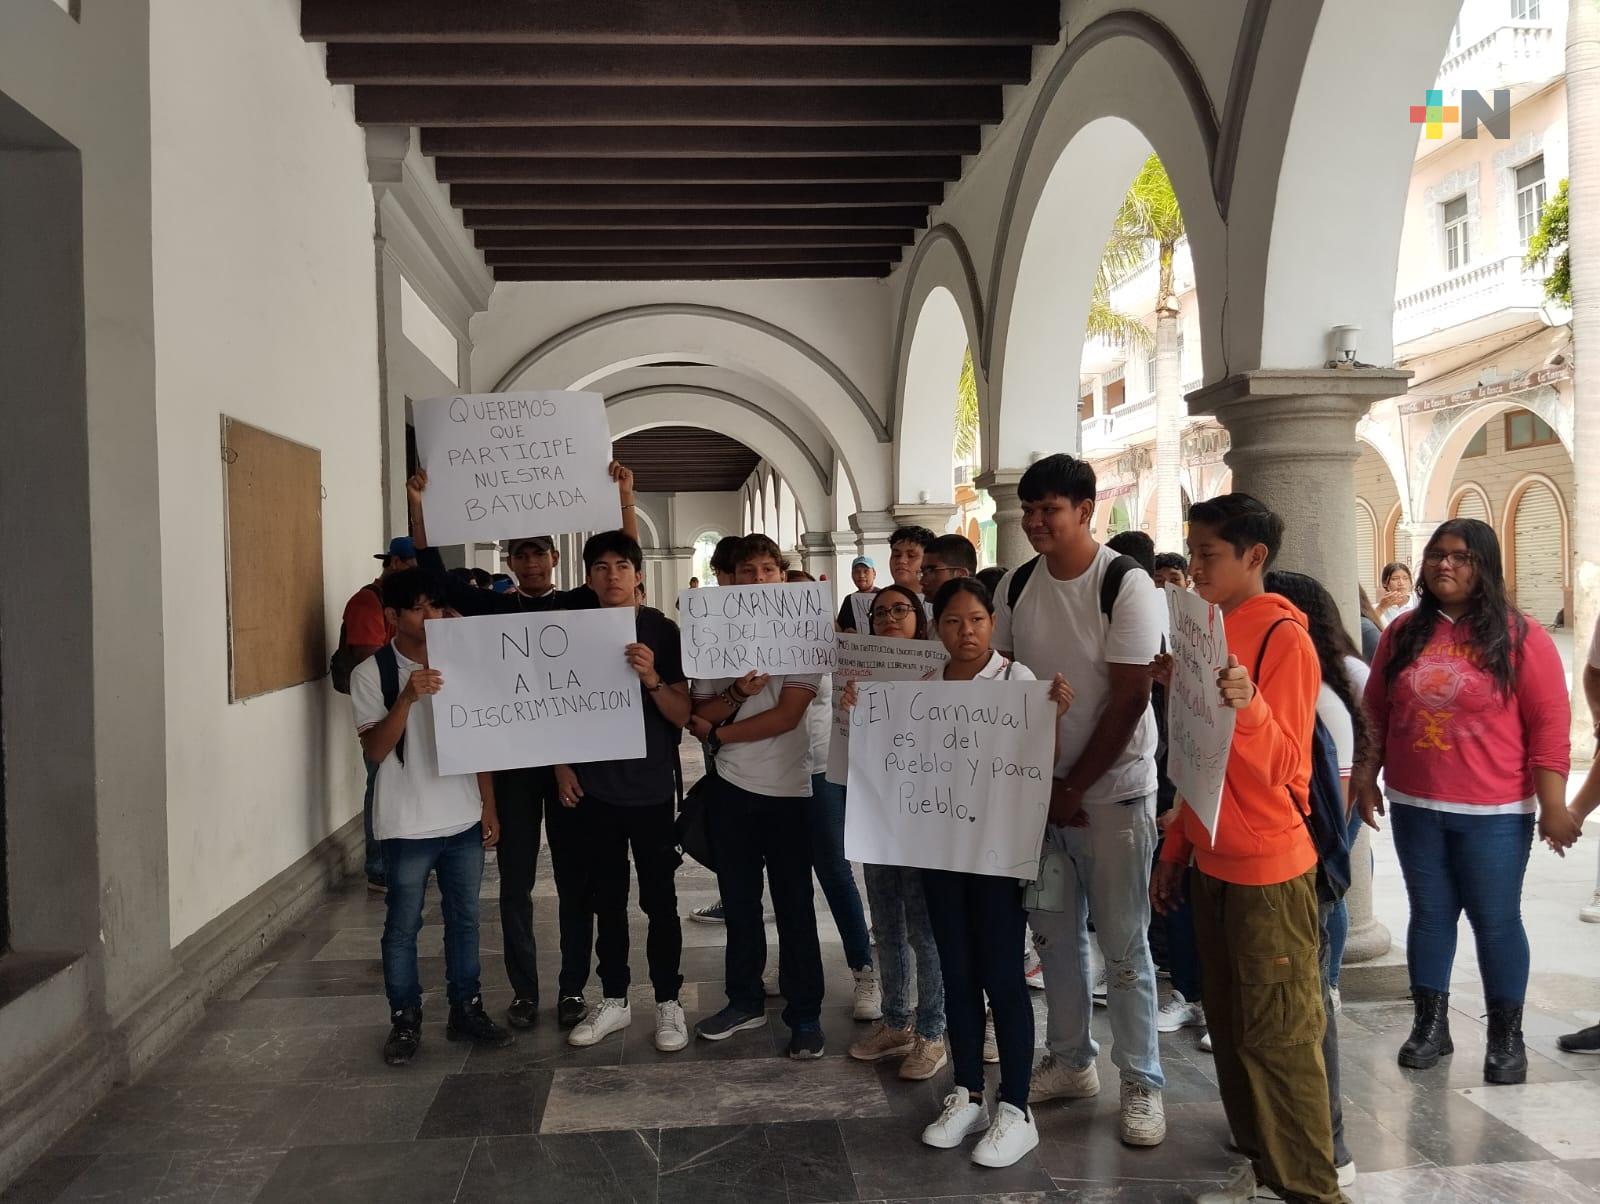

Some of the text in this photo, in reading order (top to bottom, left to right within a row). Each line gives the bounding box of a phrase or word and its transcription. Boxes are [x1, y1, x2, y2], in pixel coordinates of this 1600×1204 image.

[449, 398, 557, 423] QUEREMOS
[490, 425, 525, 439] QUE
[447, 438, 577, 466] PARTICIPE
[474, 465, 565, 489] NUESTRA
[464, 487, 587, 521] BATUCADA
[722, 588, 831, 619] CARNAVAL
[502, 624, 569, 660] NO
[723, 622, 767, 642] DEL
[767, 619, 835, 644] PUEBLO
[688, 647, 700, 673] Y
[515, 669, 581, 694] A LA
[450, 688, 632, 728] DISCRIMINACION
[869, 689, 1029, 730] El Carnaval
[893, 726, 979, 750] es del
[885, 752, 953, 774] Pueblo
